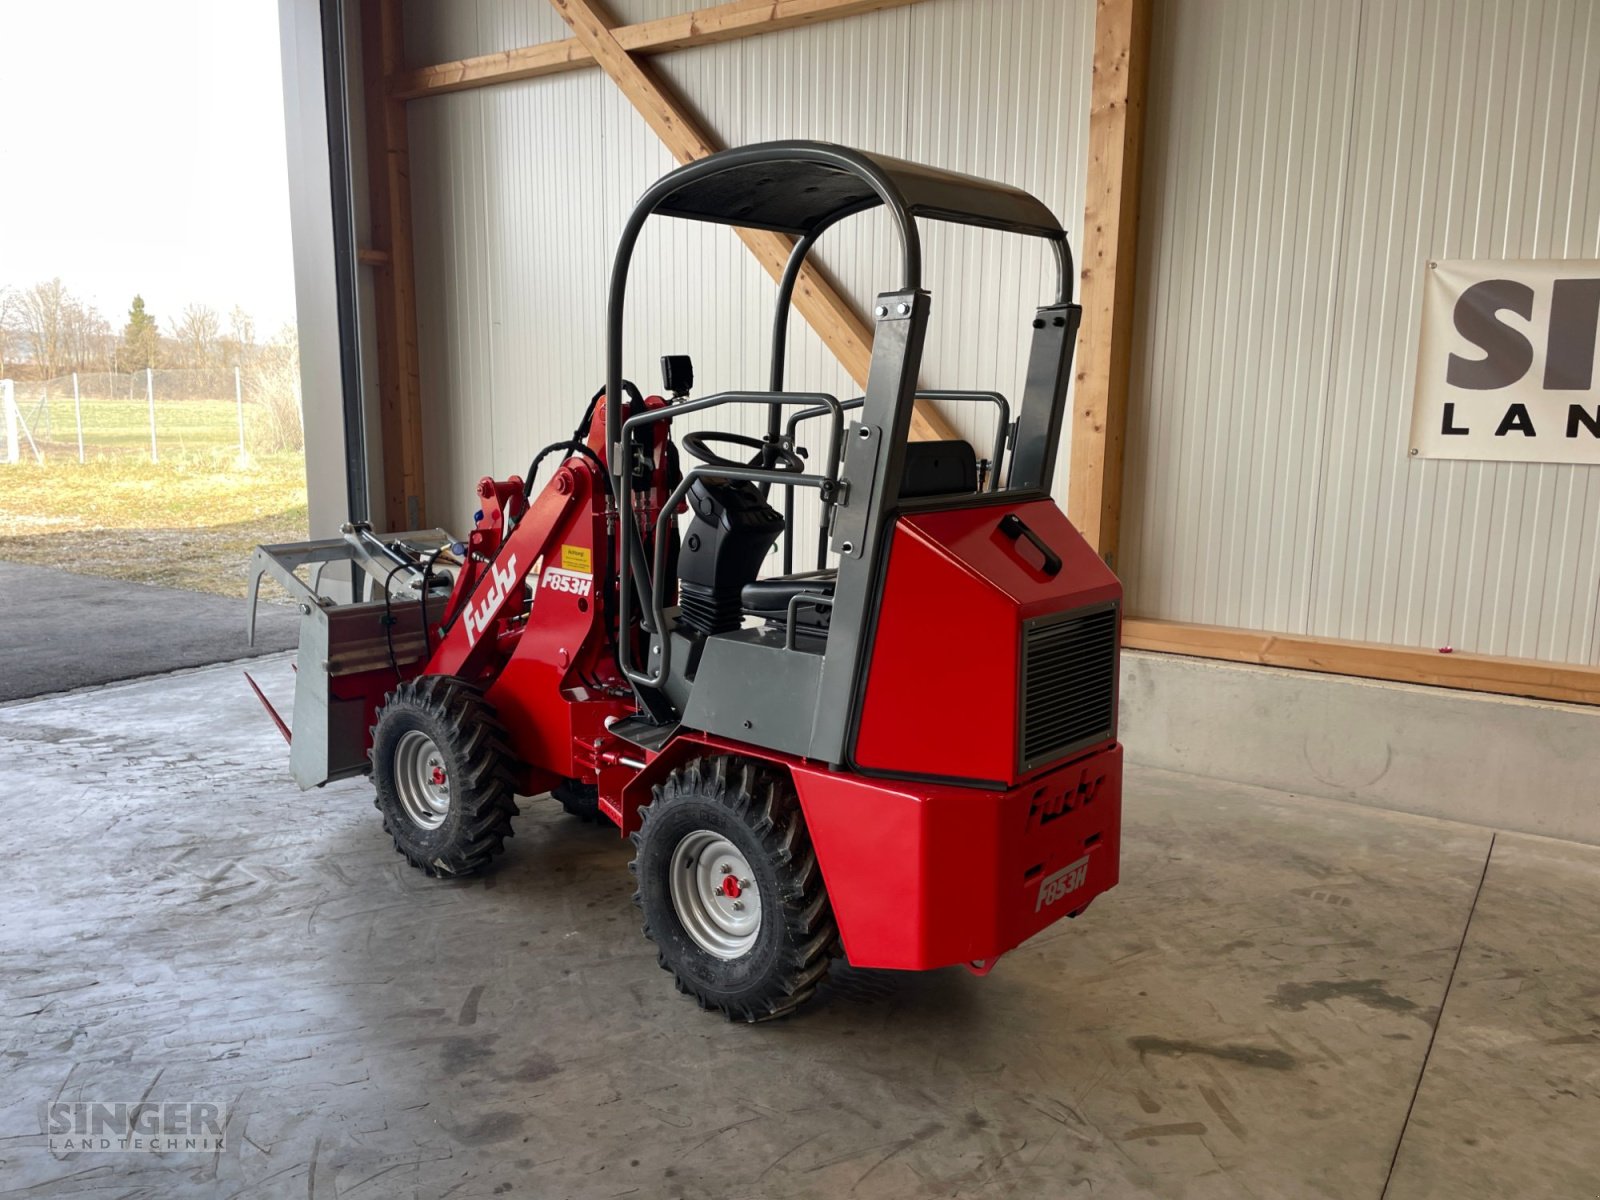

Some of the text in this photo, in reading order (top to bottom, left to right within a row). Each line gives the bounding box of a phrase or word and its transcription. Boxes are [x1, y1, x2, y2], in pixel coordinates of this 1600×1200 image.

[1441, 402, 1600, 438] LAN
[462, 553, 517, 648] Fuchs
[541, 566, 594, 597] F853H
[1025, 768, 1106, 834] Fuchs
[1035, 854, 1090, 913] F853H
